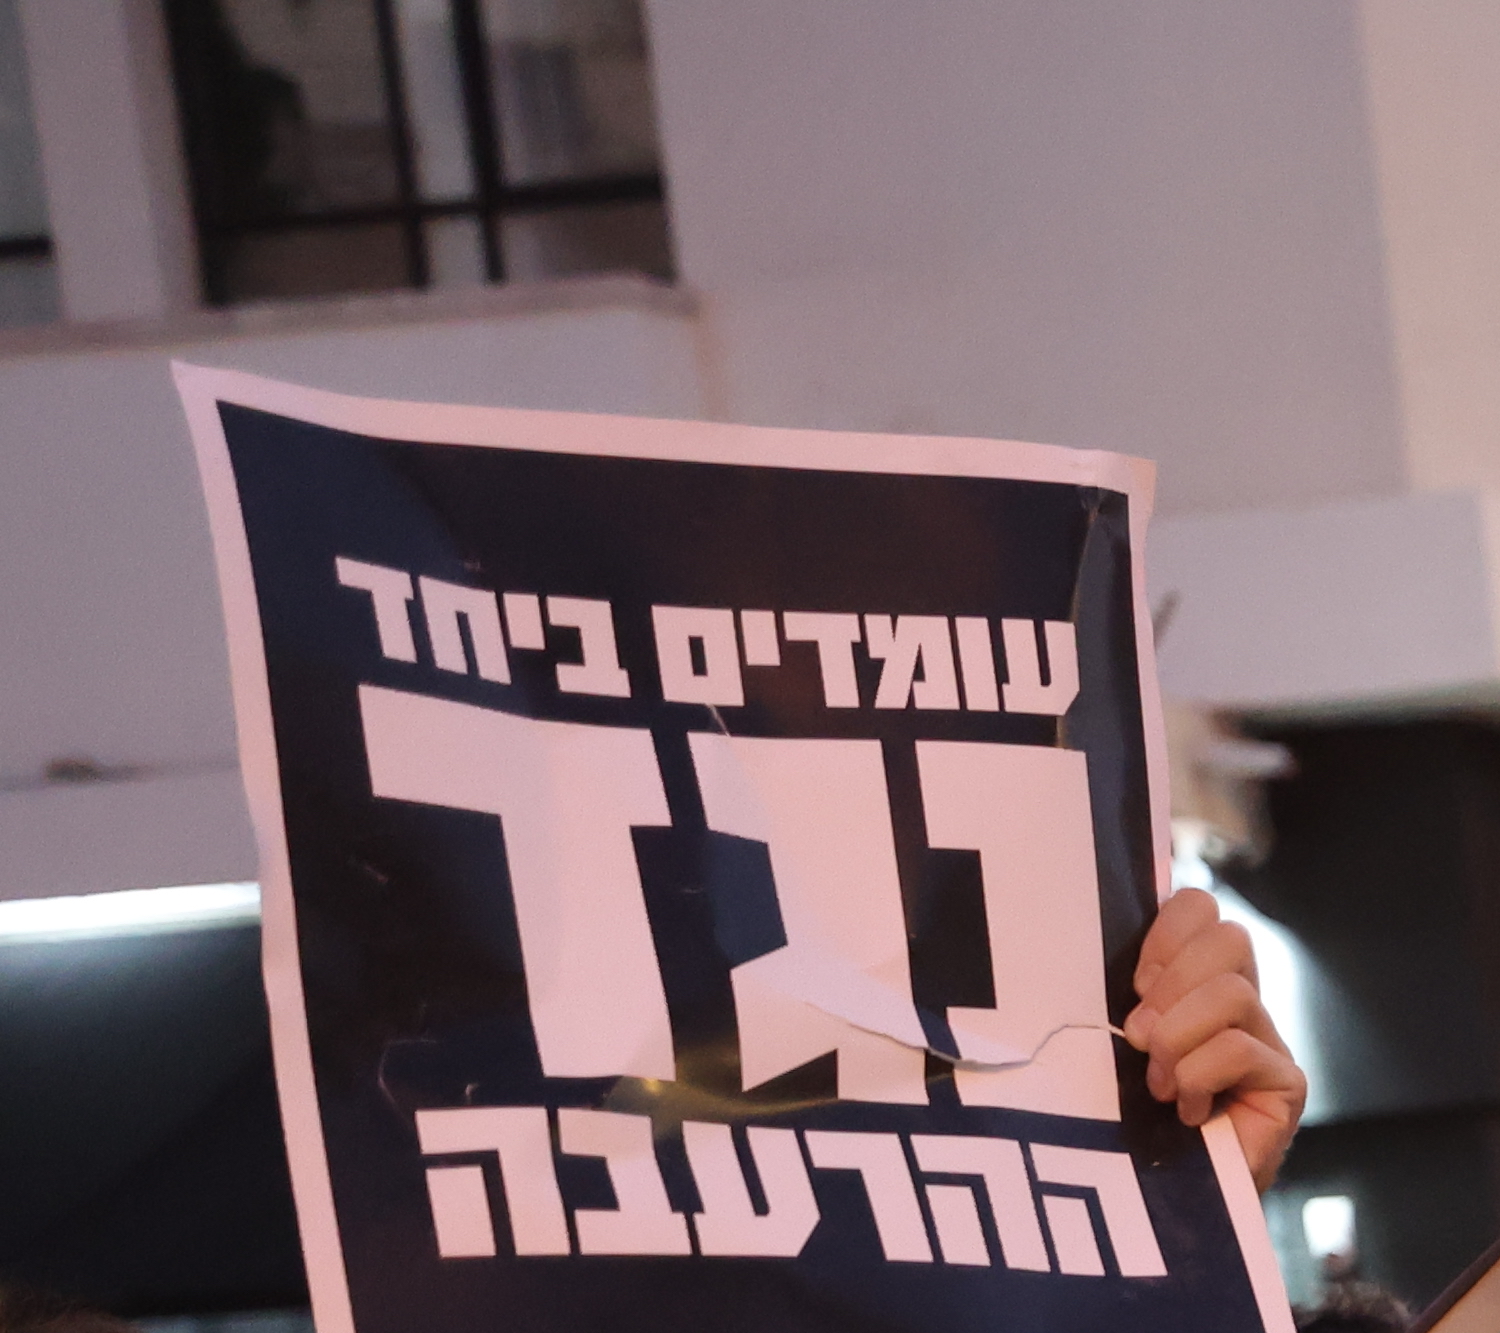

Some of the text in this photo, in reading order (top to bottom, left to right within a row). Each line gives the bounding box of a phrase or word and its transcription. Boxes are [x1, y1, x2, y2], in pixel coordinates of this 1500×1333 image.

[335, 554, 1081, 717] עומדים ביחד
[358, 682, 1123, 1121] נגד
[415, 1106, 1168, 1278] ההרעבה
